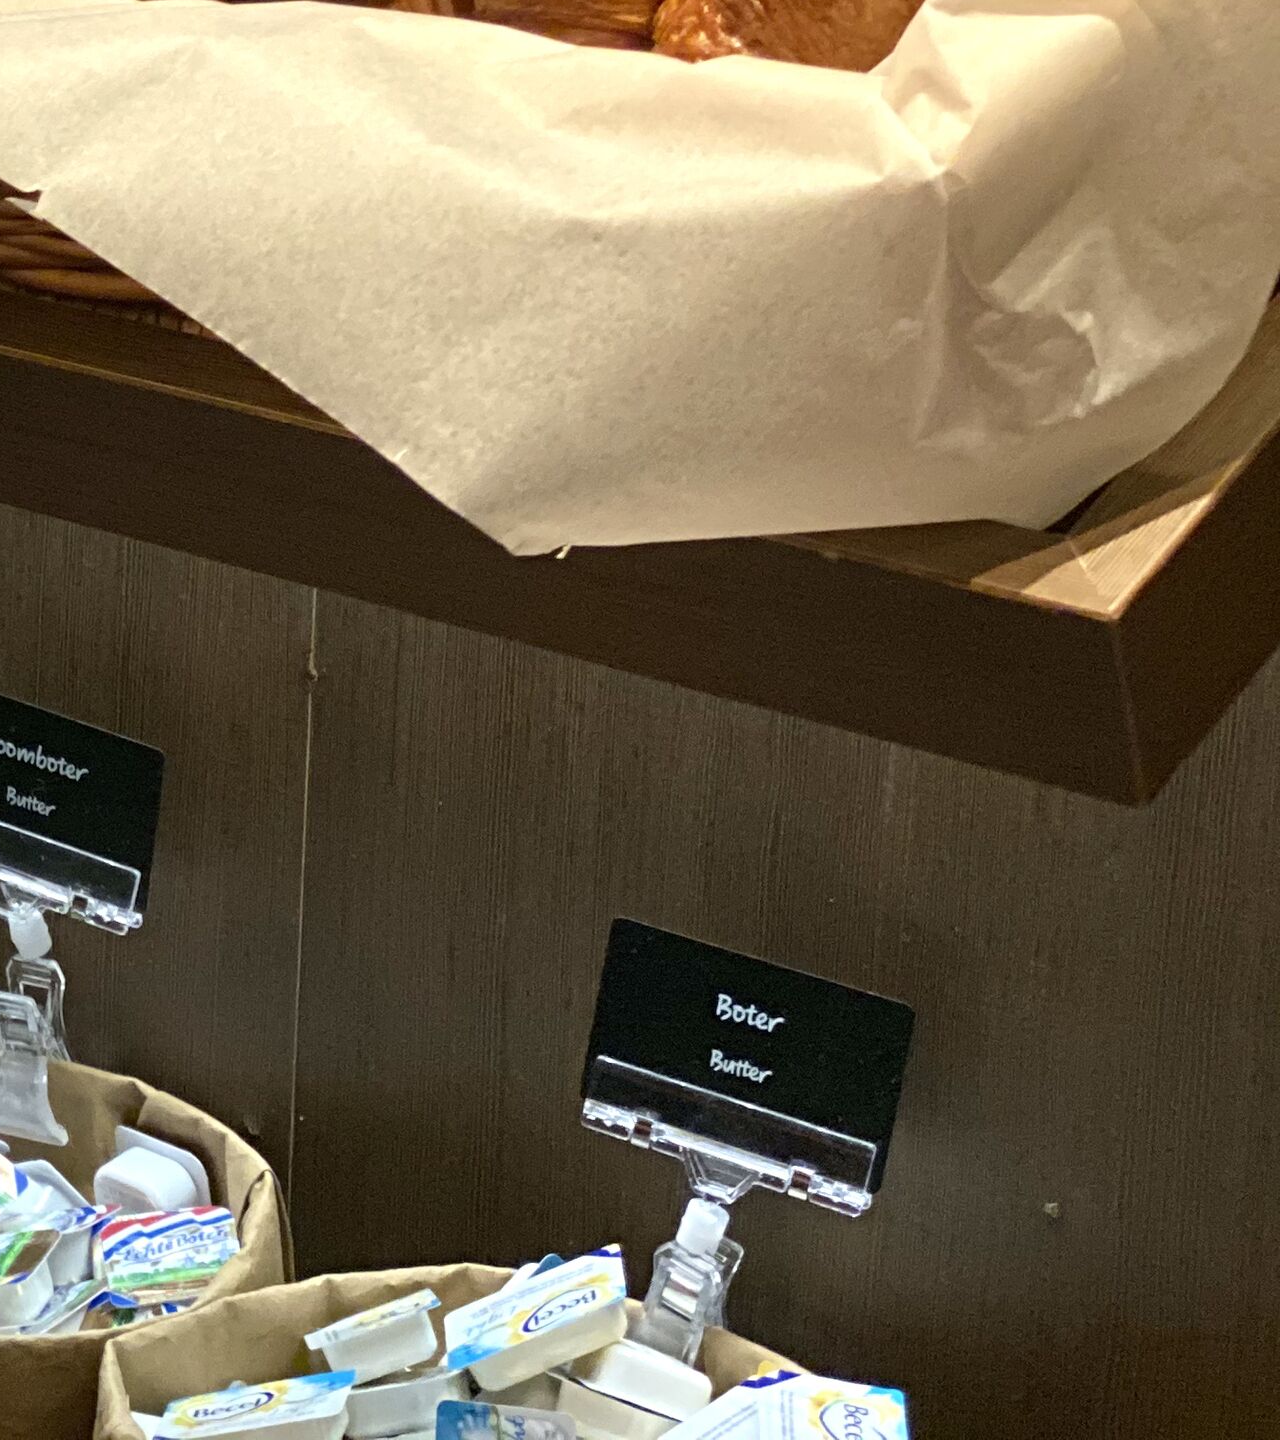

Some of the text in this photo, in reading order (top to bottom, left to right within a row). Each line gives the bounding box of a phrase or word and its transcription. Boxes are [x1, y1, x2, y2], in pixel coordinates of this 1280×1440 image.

[6, 785, 57, 817] Butter
[715, 993, 785, 1033] Boter
[710, 1049, 773, 1084] Butter
[843, 1402, 869, 1440] Bece
